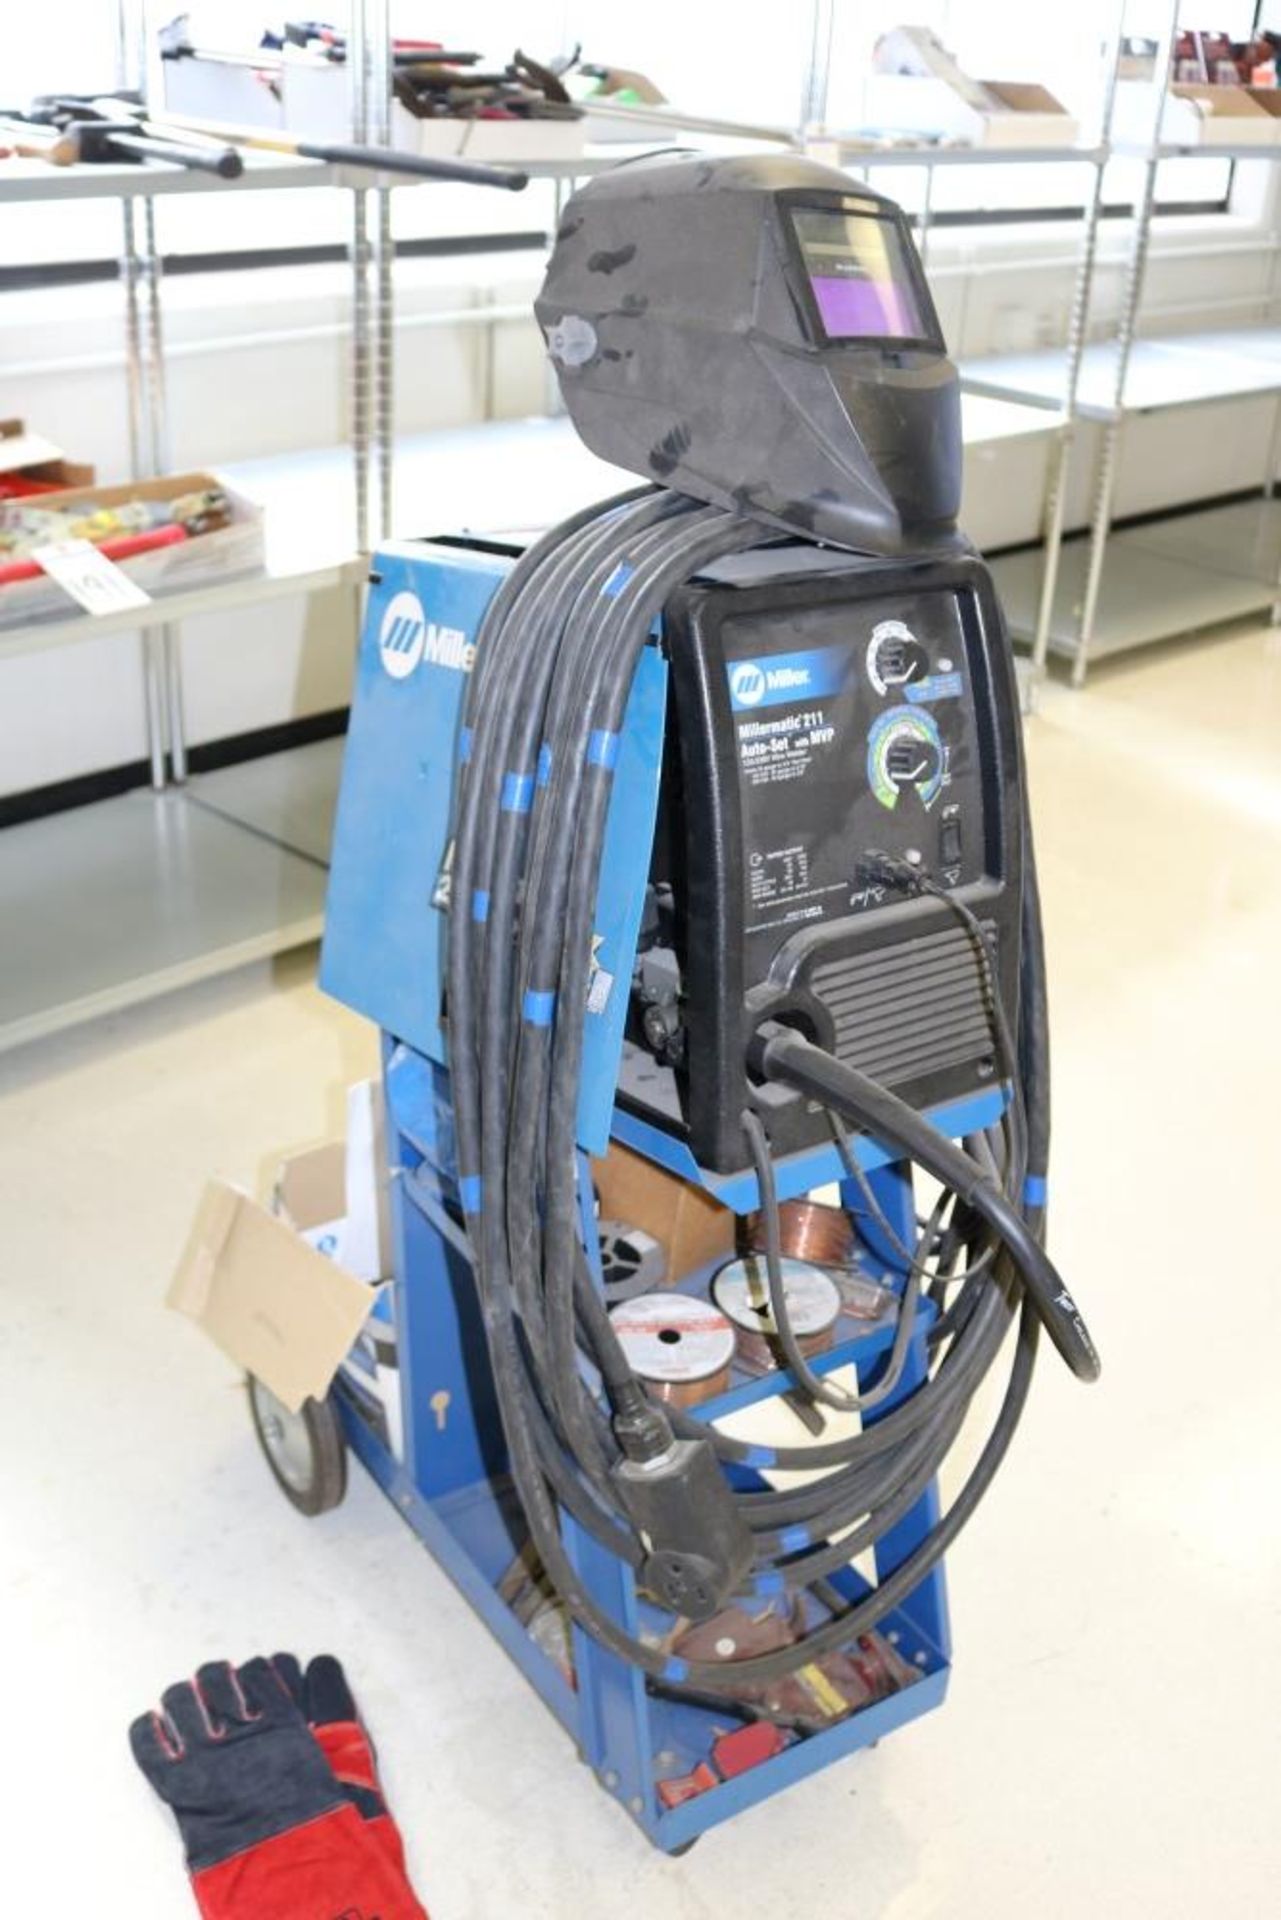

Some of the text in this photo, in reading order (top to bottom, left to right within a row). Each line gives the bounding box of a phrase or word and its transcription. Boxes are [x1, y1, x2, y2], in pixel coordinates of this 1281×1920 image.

[423, 623, 476, 672] Mille
[739, 711, 823, 739] Millermatic 211
[741, 737, 788, 757] Auto-Set
[810, 727, 835, 746] MVP
